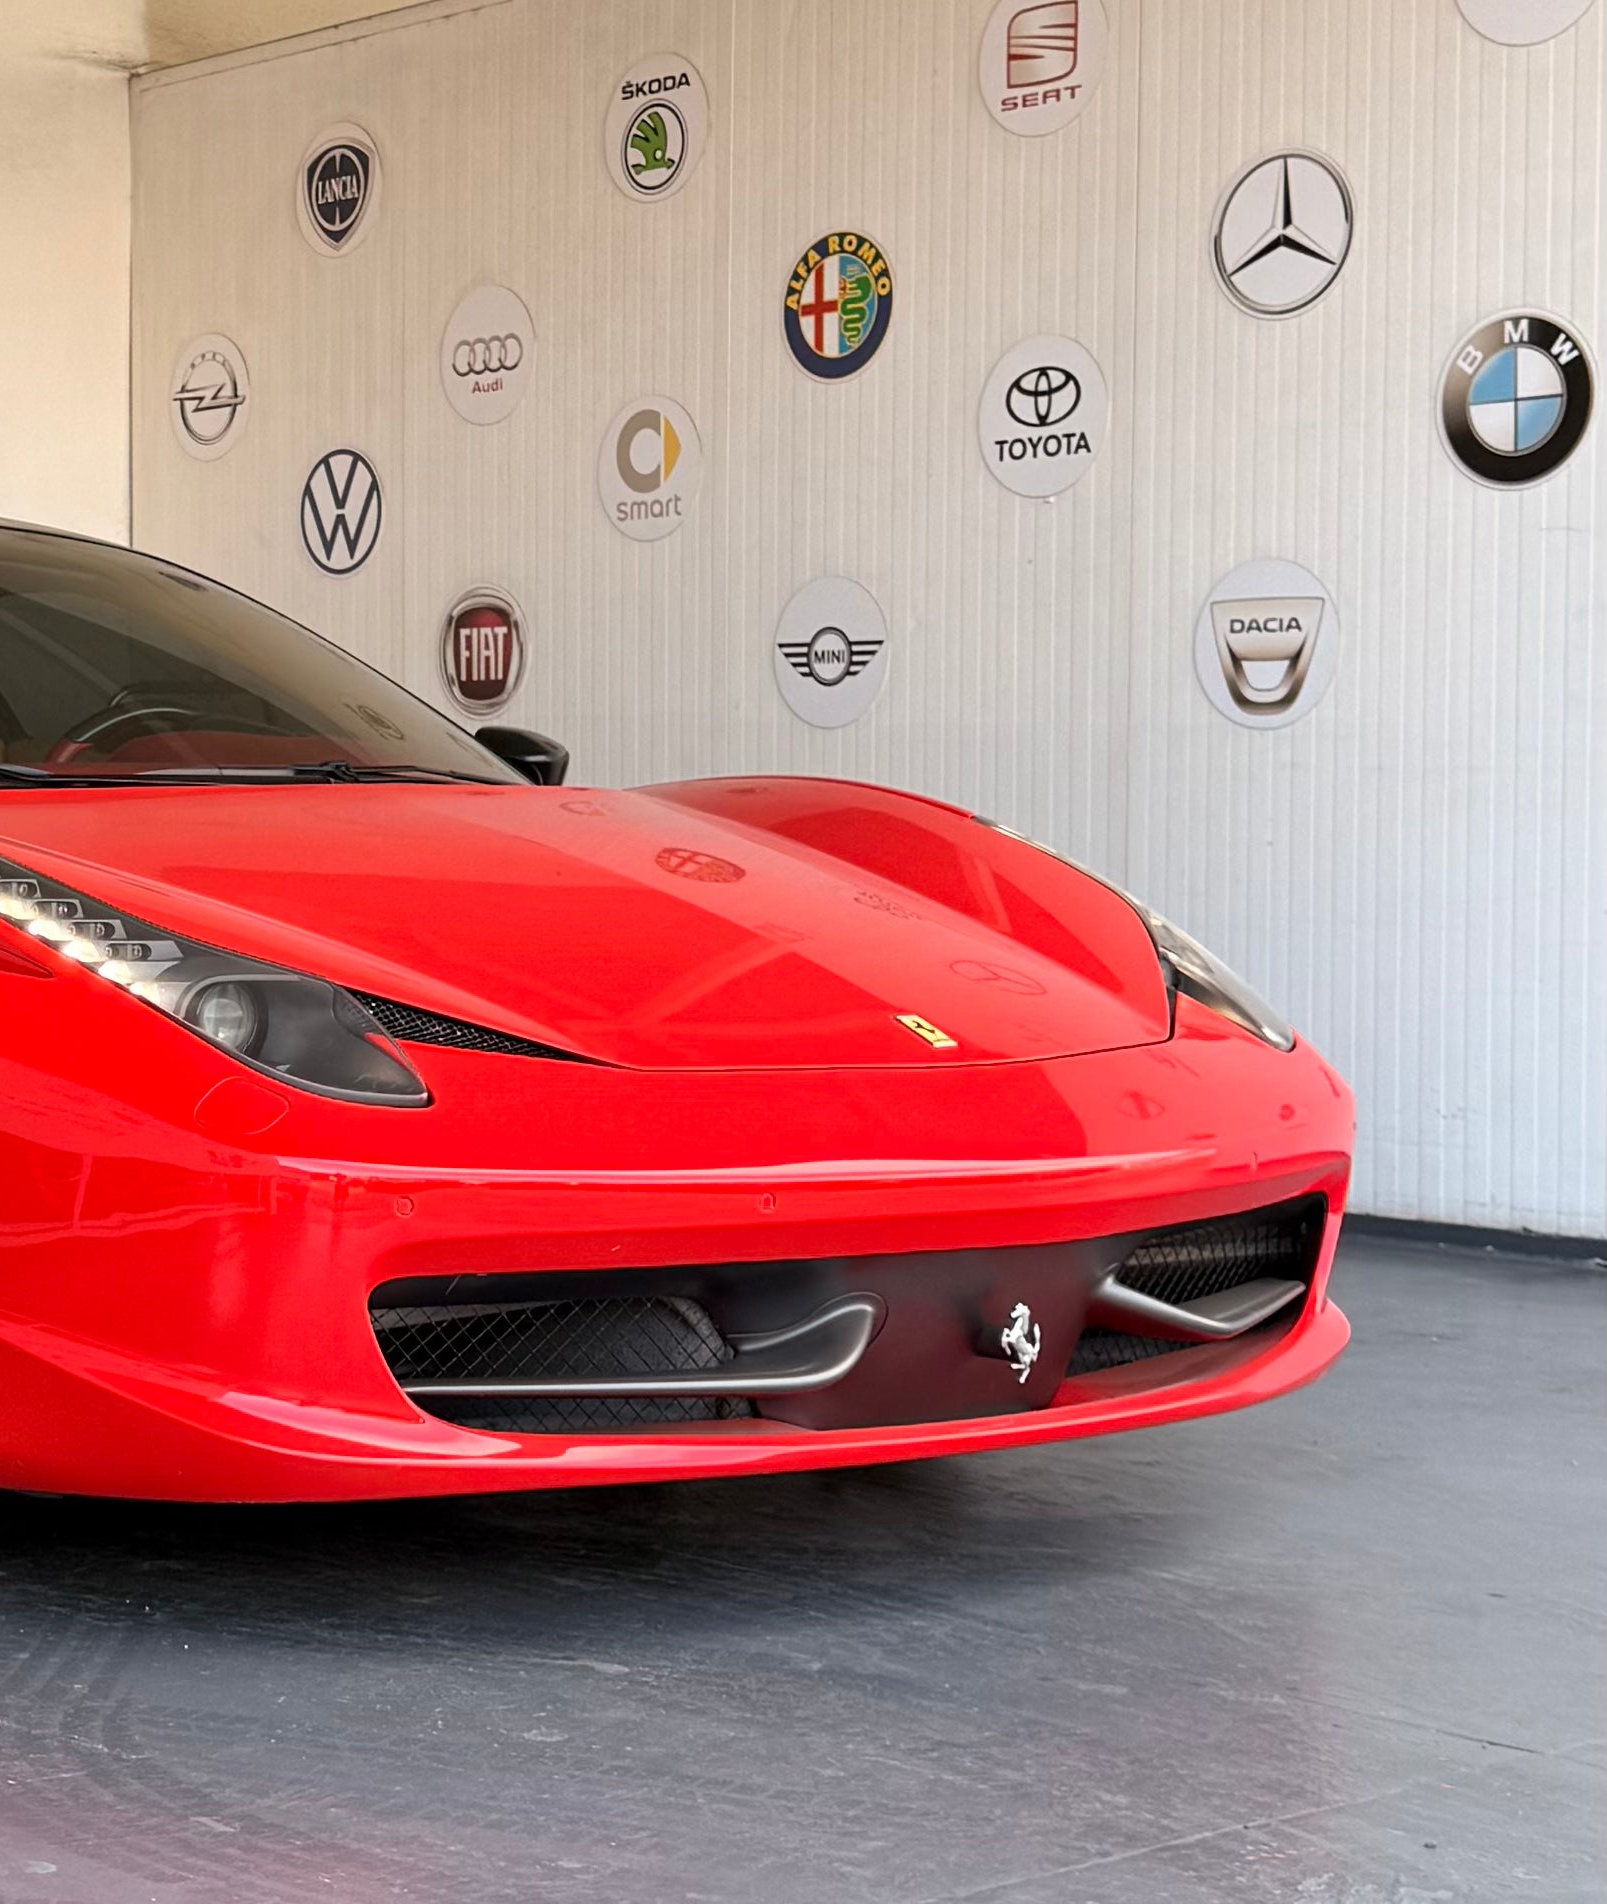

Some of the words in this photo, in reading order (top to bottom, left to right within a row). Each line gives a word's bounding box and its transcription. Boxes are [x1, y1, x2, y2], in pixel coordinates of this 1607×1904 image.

[621, 72, 691, 101] ŠKODA
[1001, 84, 1083, 112] SEAT
[317, 174, 359, 205] LANCIA
[786, 249, 822, 311] ALFA
[827, 235, 890, 296] ROMEO
[1456, 318, 1579, 375] BMW
[471, 378, 504, 395] Audi
[994, 432, 1092, 462] TOYOTA
[616, 493, 682, 522] smart
[1229, 617, 1302, 634] DACIA
[459, 626, 508, 682] FIAT
[814, 649, 845, 664] MINI
